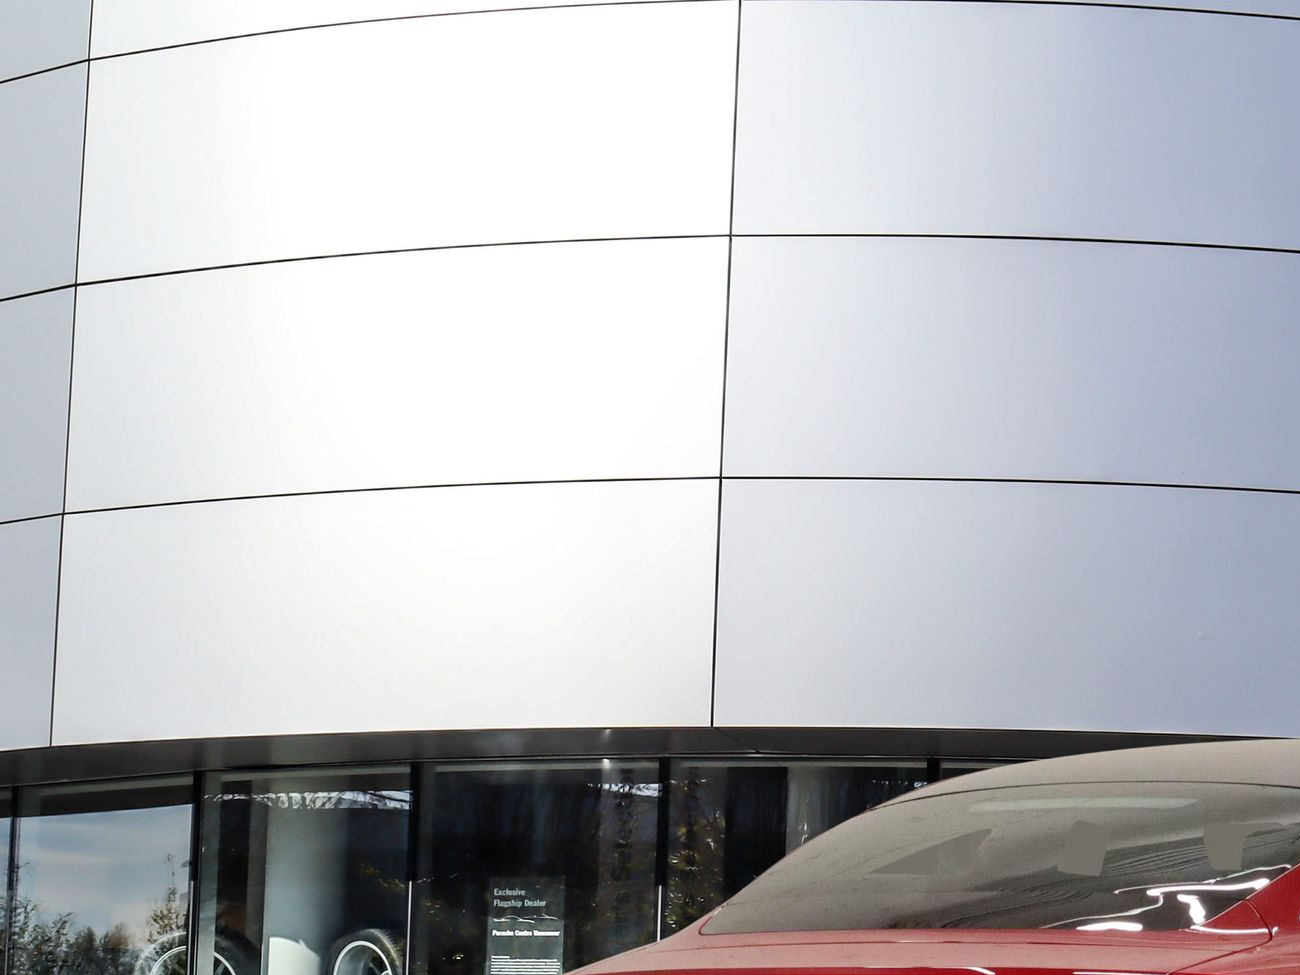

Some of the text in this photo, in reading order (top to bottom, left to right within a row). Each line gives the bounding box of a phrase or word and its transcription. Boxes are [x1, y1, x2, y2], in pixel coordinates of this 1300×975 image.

[494, 888, 526, 896] Exclusive
[494, 899, 546, 907] Flagship Dealer
